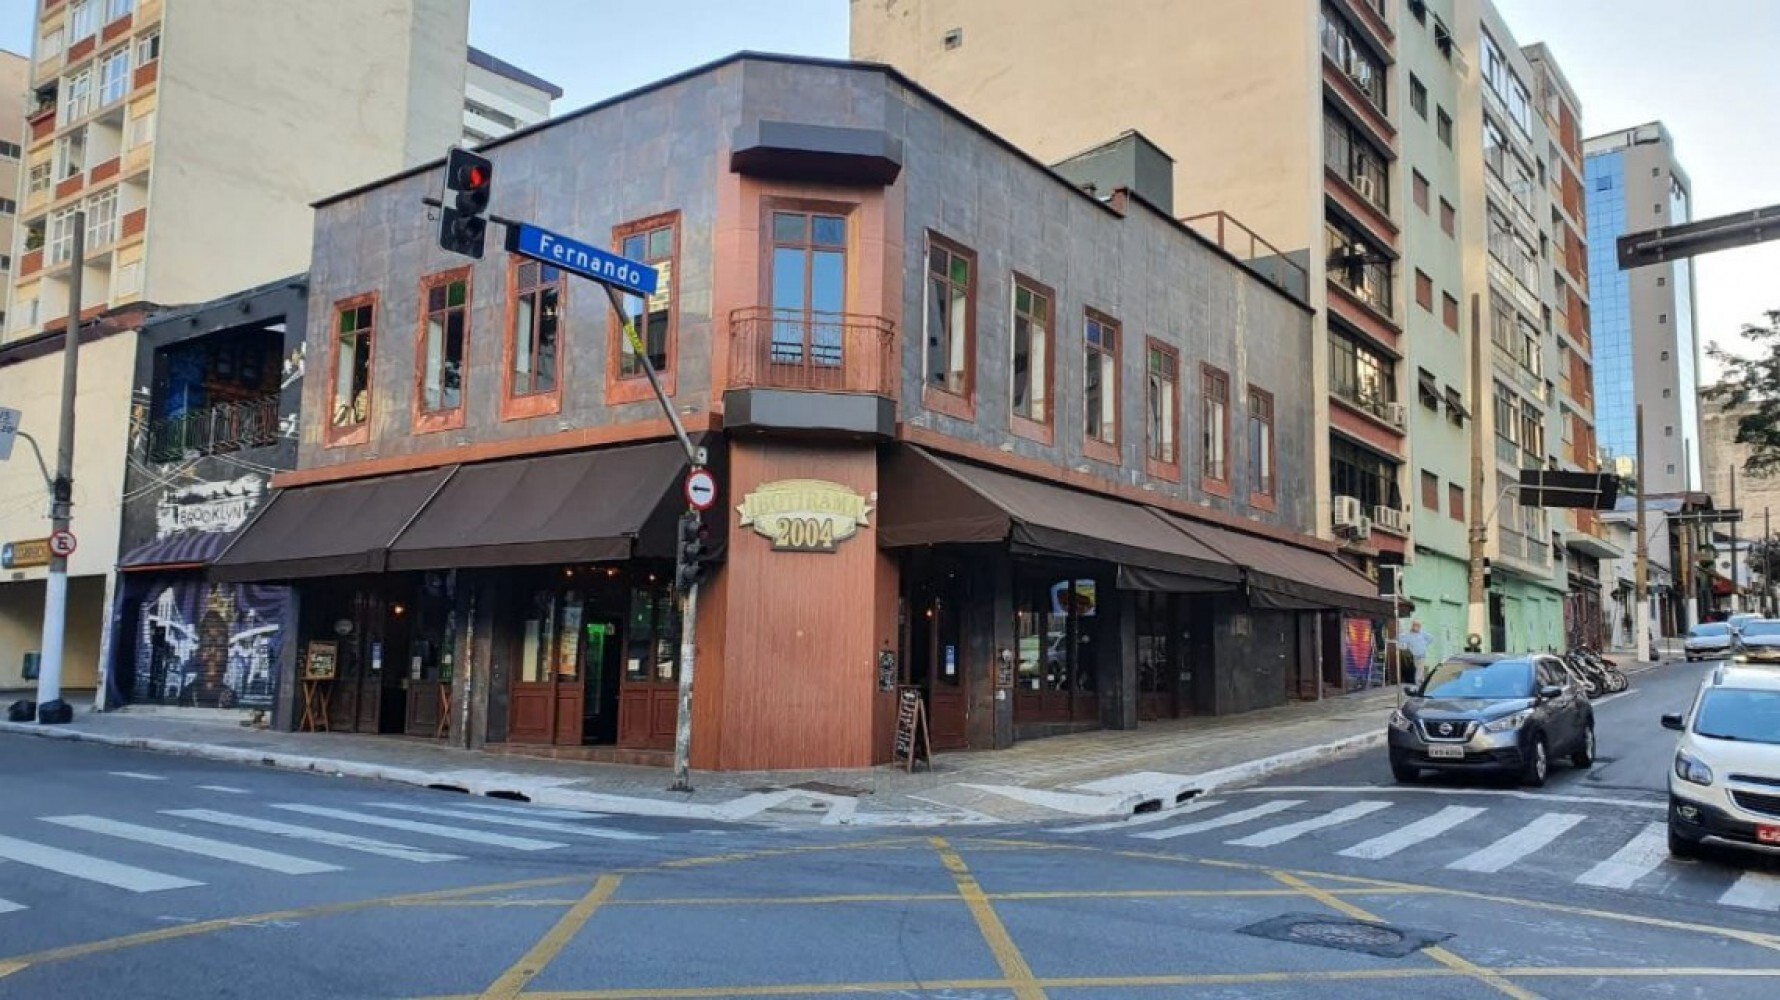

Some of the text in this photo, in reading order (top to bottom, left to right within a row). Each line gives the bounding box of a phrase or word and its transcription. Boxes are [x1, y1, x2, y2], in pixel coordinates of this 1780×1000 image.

[539, 234, 641, 285] Fernando
[180, 503, 242, 525] BROOKLYN
[775, 518, 834, 547] 2004
